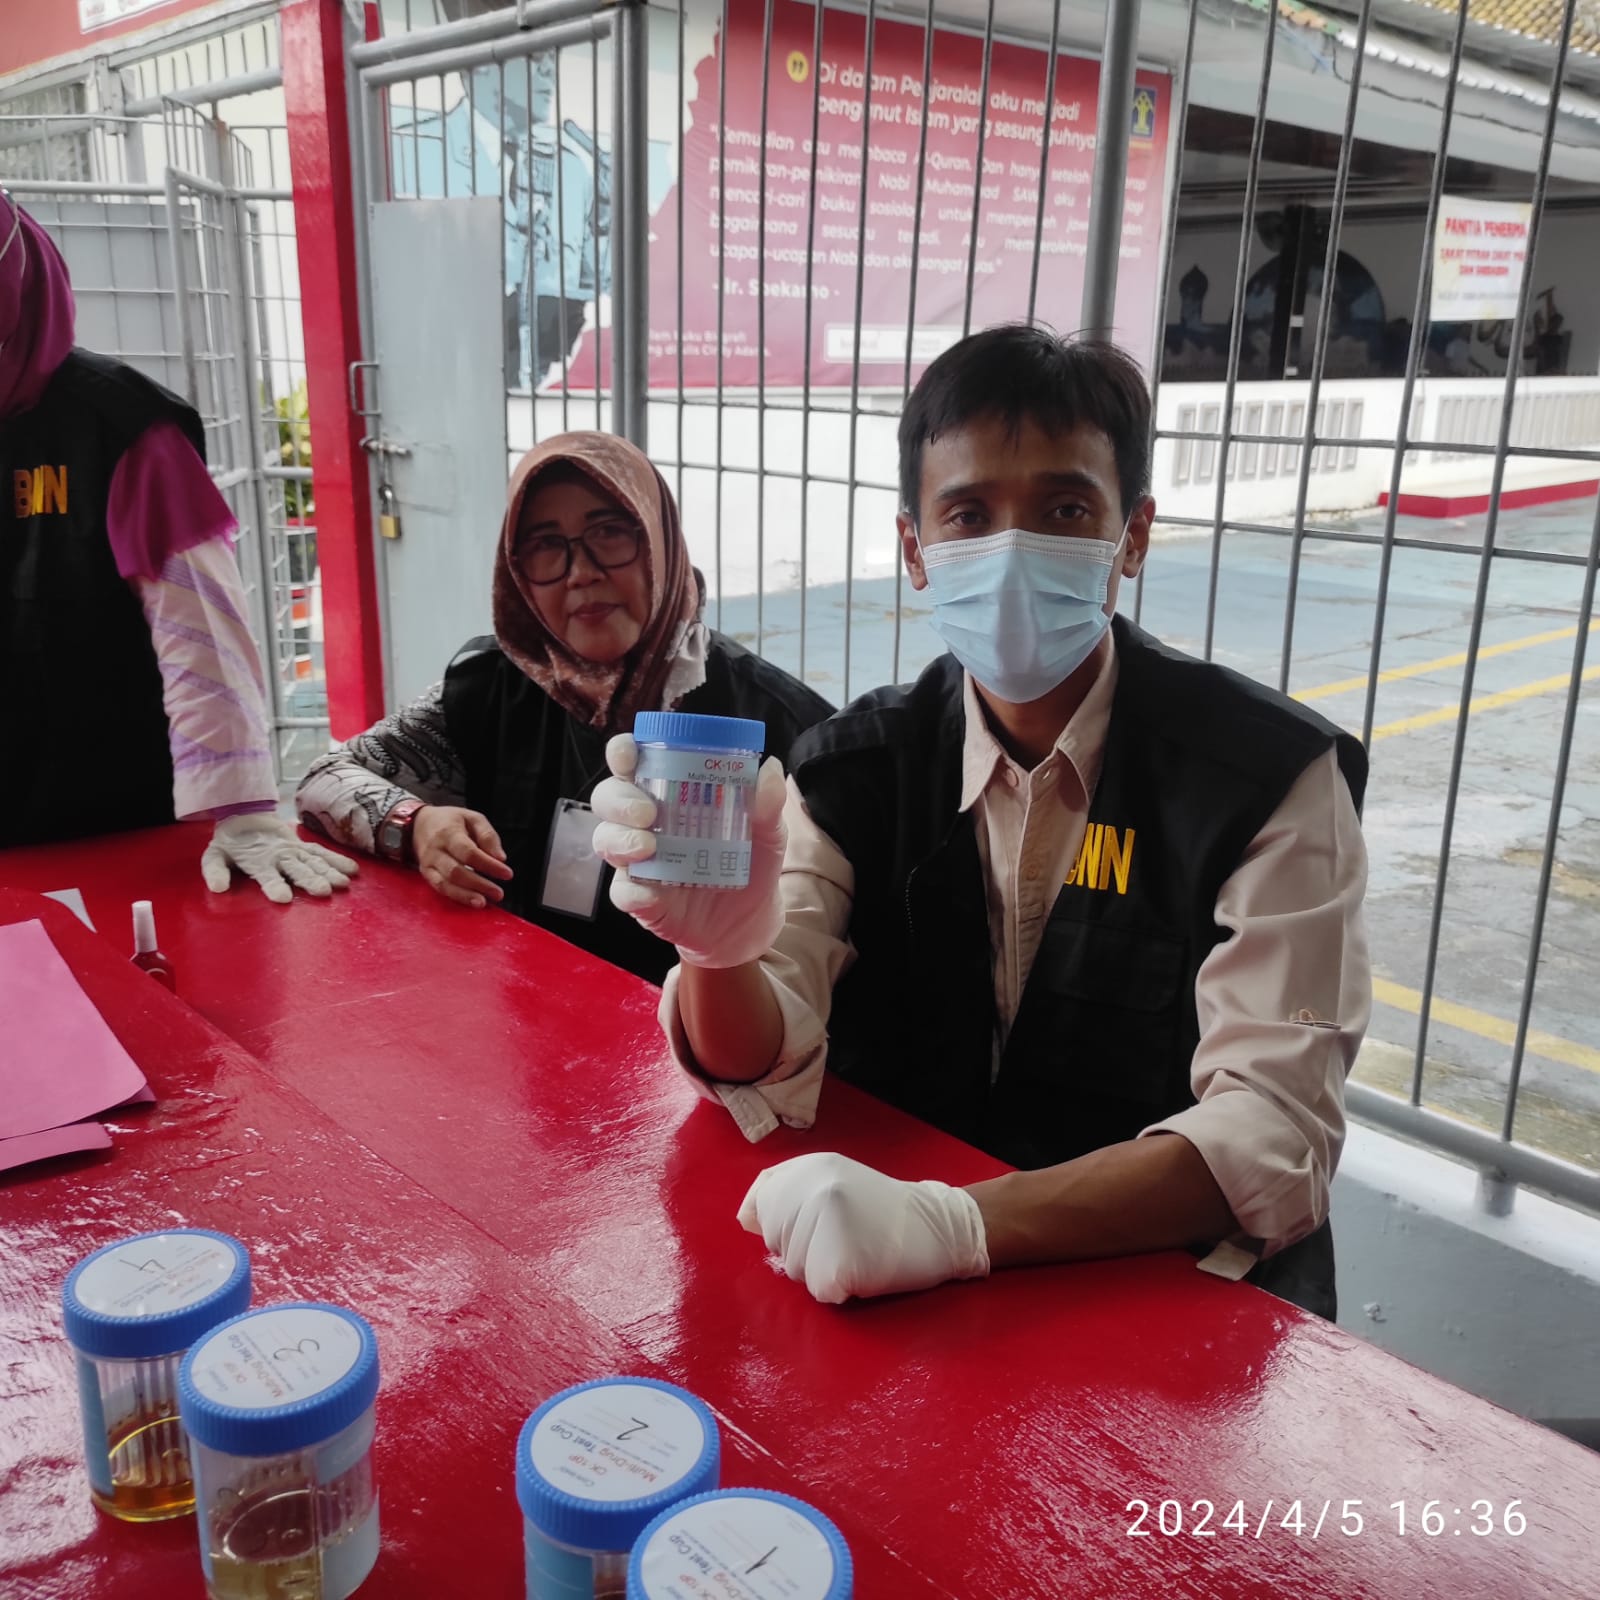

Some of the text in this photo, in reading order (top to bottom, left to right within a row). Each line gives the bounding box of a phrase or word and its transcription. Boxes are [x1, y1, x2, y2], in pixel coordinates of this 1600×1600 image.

[839, 66, 897, 94] daam
[900, 74, 982, 106] Pejarala
[990, 91, 1019, 113] aku
[1022, 98, 1079, 123] mejadi
[818, 95, 902, 124] pengnut
[905, 104, 949, 129] Isam
[925, 178, 1000, 200] Muhamad
[869, 201, 925, 219] sosioloi
[961, 232, 986, 248] Au
[829, 249, 859, 266] Nab
[1064, 822, 1136, 895] NN
[616, 1416, 649, 1441] 2
